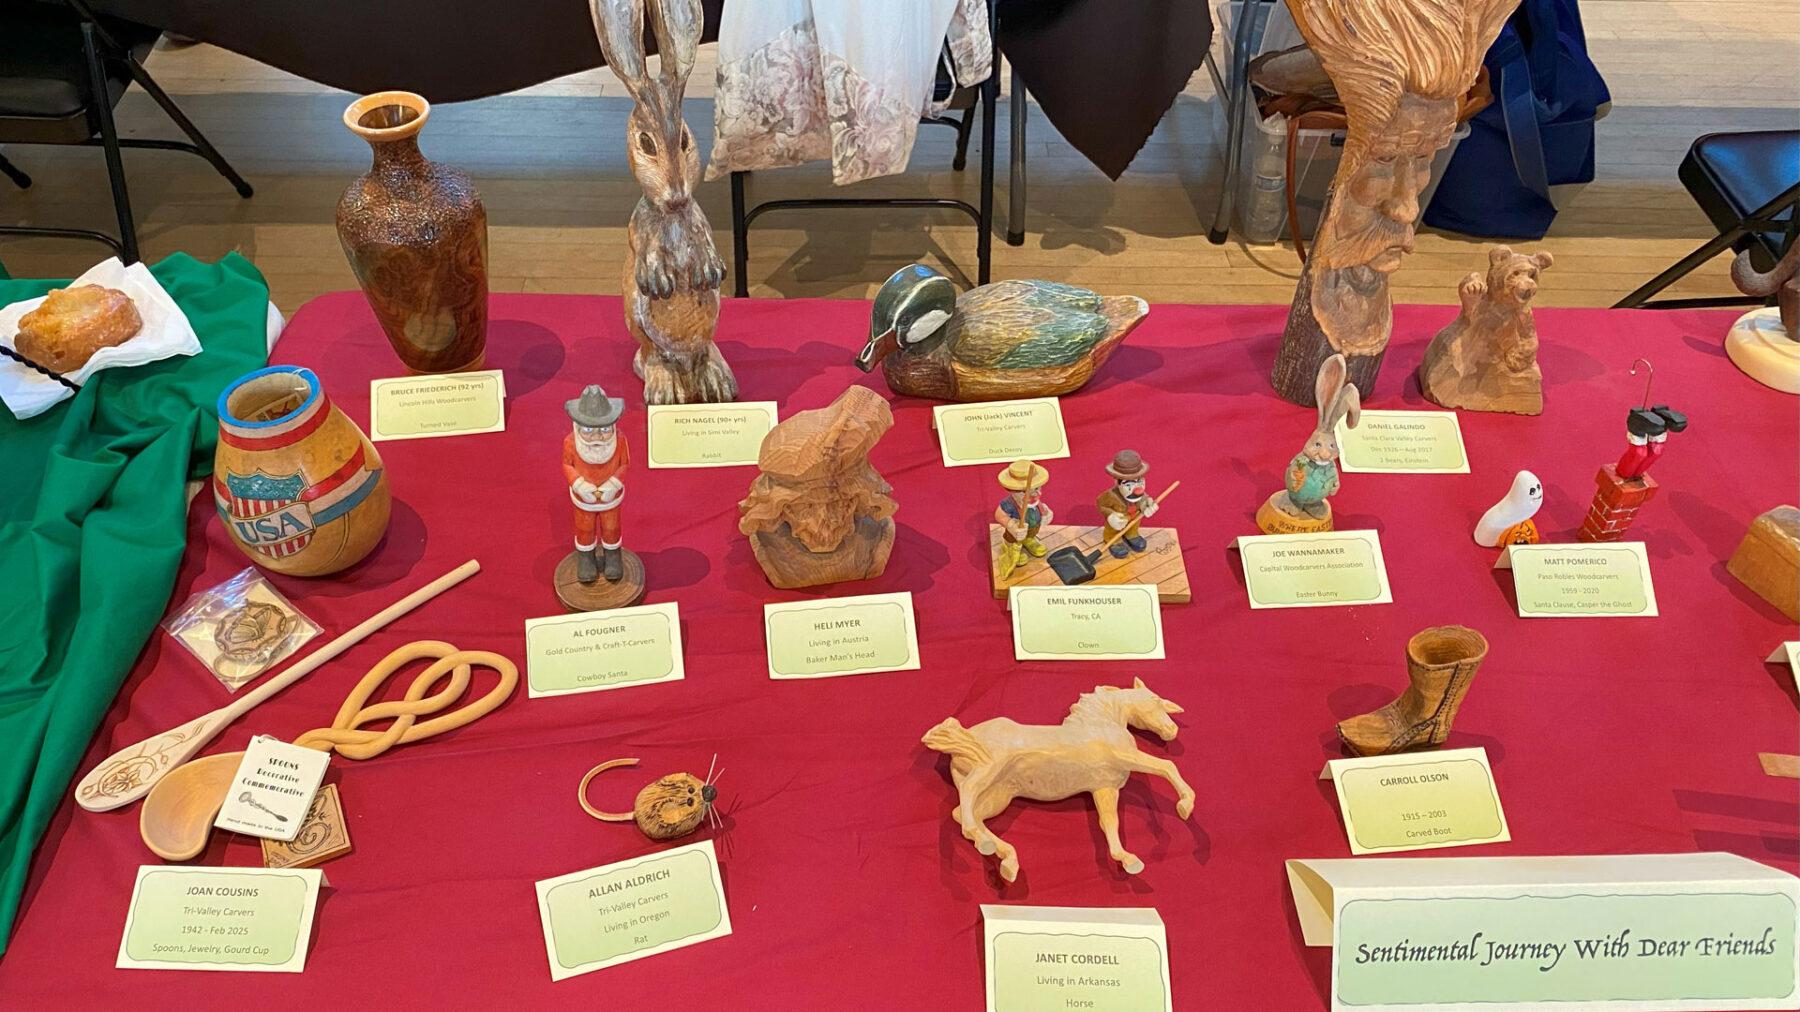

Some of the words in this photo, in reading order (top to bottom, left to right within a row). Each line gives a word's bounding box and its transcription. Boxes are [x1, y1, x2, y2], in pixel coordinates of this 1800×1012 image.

[391, 388, 413, 396] BRUCE
[416, 385, 456, 394] FRIEDERICH
[436, 396, 476, 404] Woodcarvers
[236, 512, 309, 543] USA
[1287, 548, 1345, 556] WANNAMAKER
[1260, 565, 1282, 573] Capital
[1553, 601, 1576, 609] Clause,
[1577, 601, 1599, 609] Casper
[814, 622, 833, 630] HELI
[835, 620, 860, 628] MYER
[586, 626, 626, 636] FOUGNER
[546, 648, 563, 656] Gold
[564, 645, 593, 654] Country
[603, 638, 655, 649] Craft-T-Carvers
[809, 639, 831, 647] Living
[806, 656, 827, 664] Baker
[855, 651, 875, 659] Head
[577, 674, 606, 682] Cowboy
[269, 758, 299, 770] SPOONS
[257, 768, 300, 783] Decorative
[1380, 776, 1418, 787] CARROLL
[1420, 773, 1449, 782] OLSON
[242, 778, 304, 797] Commemorative
[1402, 813, 1420, 821] 1915
[1429, 810, 1447, 818] 2003
[1406, 829, 1432, 838] Carved
[589, 881, 622, 899] ALLAN
[625, 869, 670, 889] ALDRICH
[187, 886, 213, 896] JOAN
[216, 887, 259, 897] COUSINS
[598, 902, 636, 916] Tri-Valley
[638, 892, 669, 906] Carvers
[184, 907, 221, 916] Tri-Valley
[223, 908, 254, 916] Carvers
[604, 920, 628, 934] Living
[630, 918, 638, 926] in
[640, 910, 670, 924] Oregon
[182, 926, 202, 934] 1942
[210, 926, 225, 934] Feb
[228, 927, 248, 935] 2025
[634, 935, 648, 944] Rat
[153, 944, 186, 953] Spoons,
[188, 945, 222, 954] Jewelry,
[224, 946, 250, 954] Gourd
[253, 946, 269, 955] Cup
[1355, 933, 1483, 964] Sentimental
[1480, 940, 1566, 972] Journey
[1574, 928, 1631, 959] With
[1637, 939, 1691, 957] Dear
[1695, 927, 1776, 956] Friends
[1036, 954, 1068, 964] JANET
[1071, 955, 1119, 965] CORDELL
[1037, 976, 1064, 987] Living
[1067, 977, 1076, 985] in
[1078, 977, 1120, 987] Arkansas
[1066, 1000, 1094, 1008] Horse
